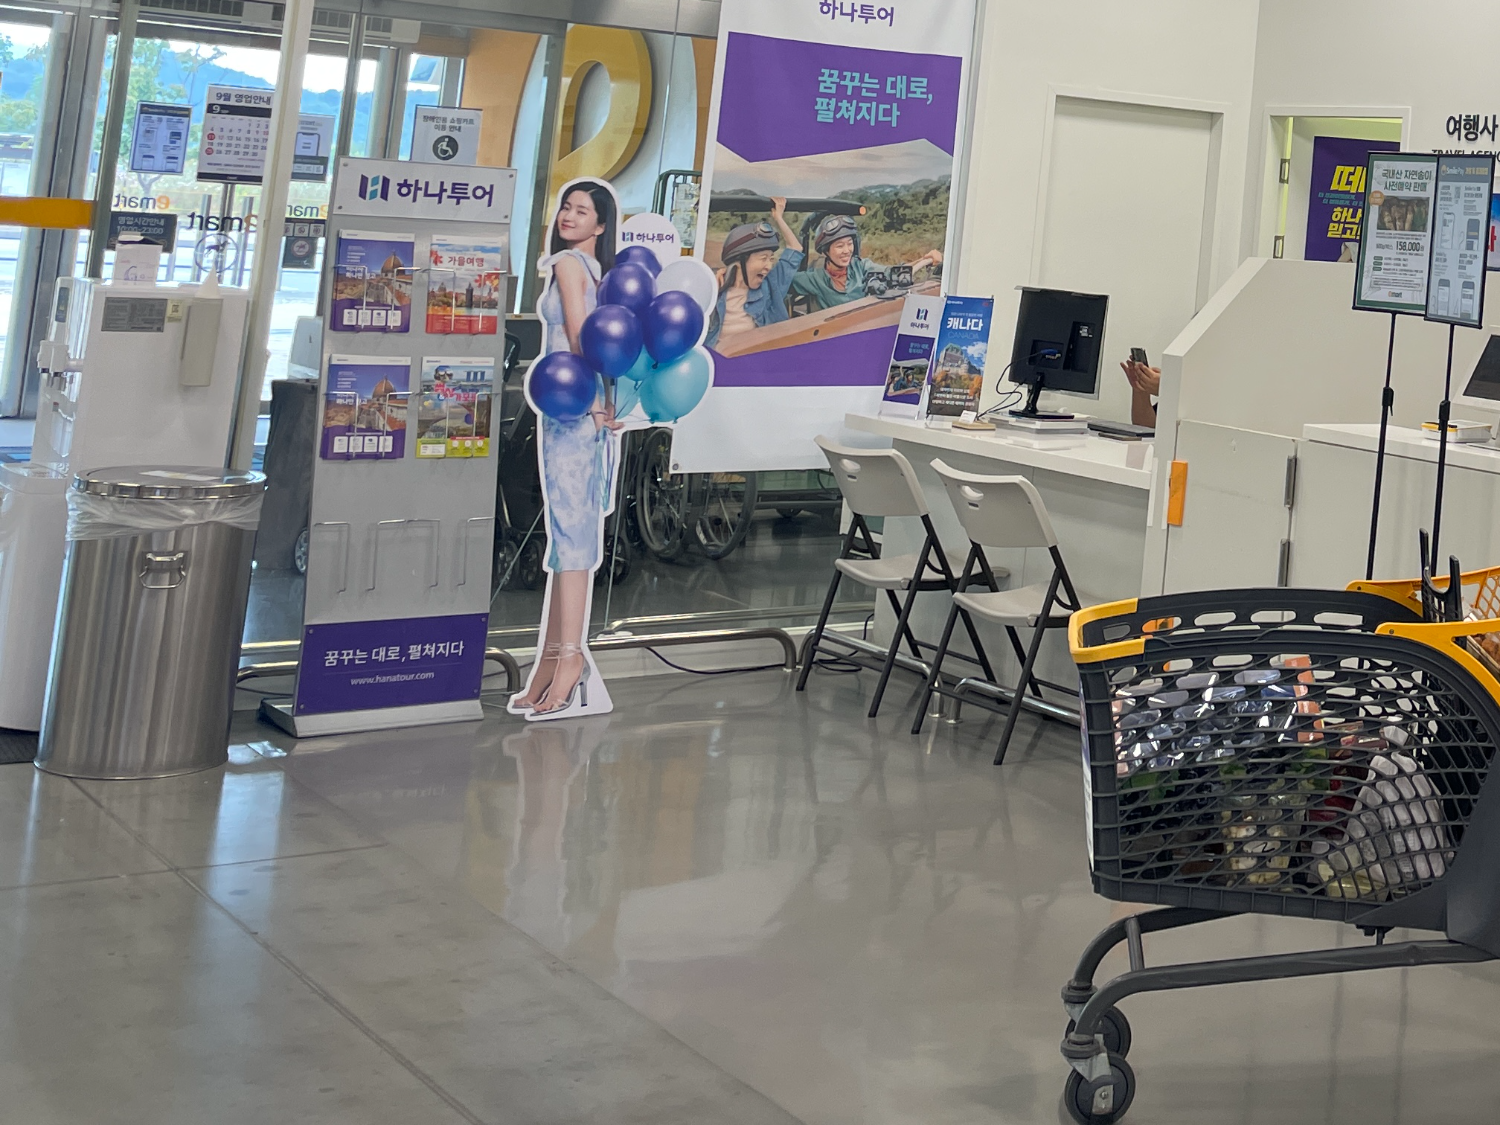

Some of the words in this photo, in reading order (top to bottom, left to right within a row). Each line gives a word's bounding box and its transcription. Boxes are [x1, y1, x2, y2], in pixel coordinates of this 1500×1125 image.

[819, 0, 895, 27] 하나투어
[818, 68, 880, 98] 꿈꾸는
[885, 75, 933, 105] 대로,
[234, 93, 271, 105] 영업안내
[814, 97, 900, 127] 펼쳐지다
[1446, 114, 1499, 142] 여행사
[1381, 168, 1403, 179] 국내산
[1404, 169, 1432, 180] 자연송이
[396, 178, 495, 208] 하나투어
[636, 232, 675, 244] 하나투어
[447, 256, 484, 268] 가을여행
[946, 317, 984, 331] 캐나다
[324, 649, 368, 667] 꿈꾸는
[371, 646, 406, 663] 대로,
[408, 641, 465, 660] 펼쳐지다
[350, 671, 435, 686] www.hanatour.com
